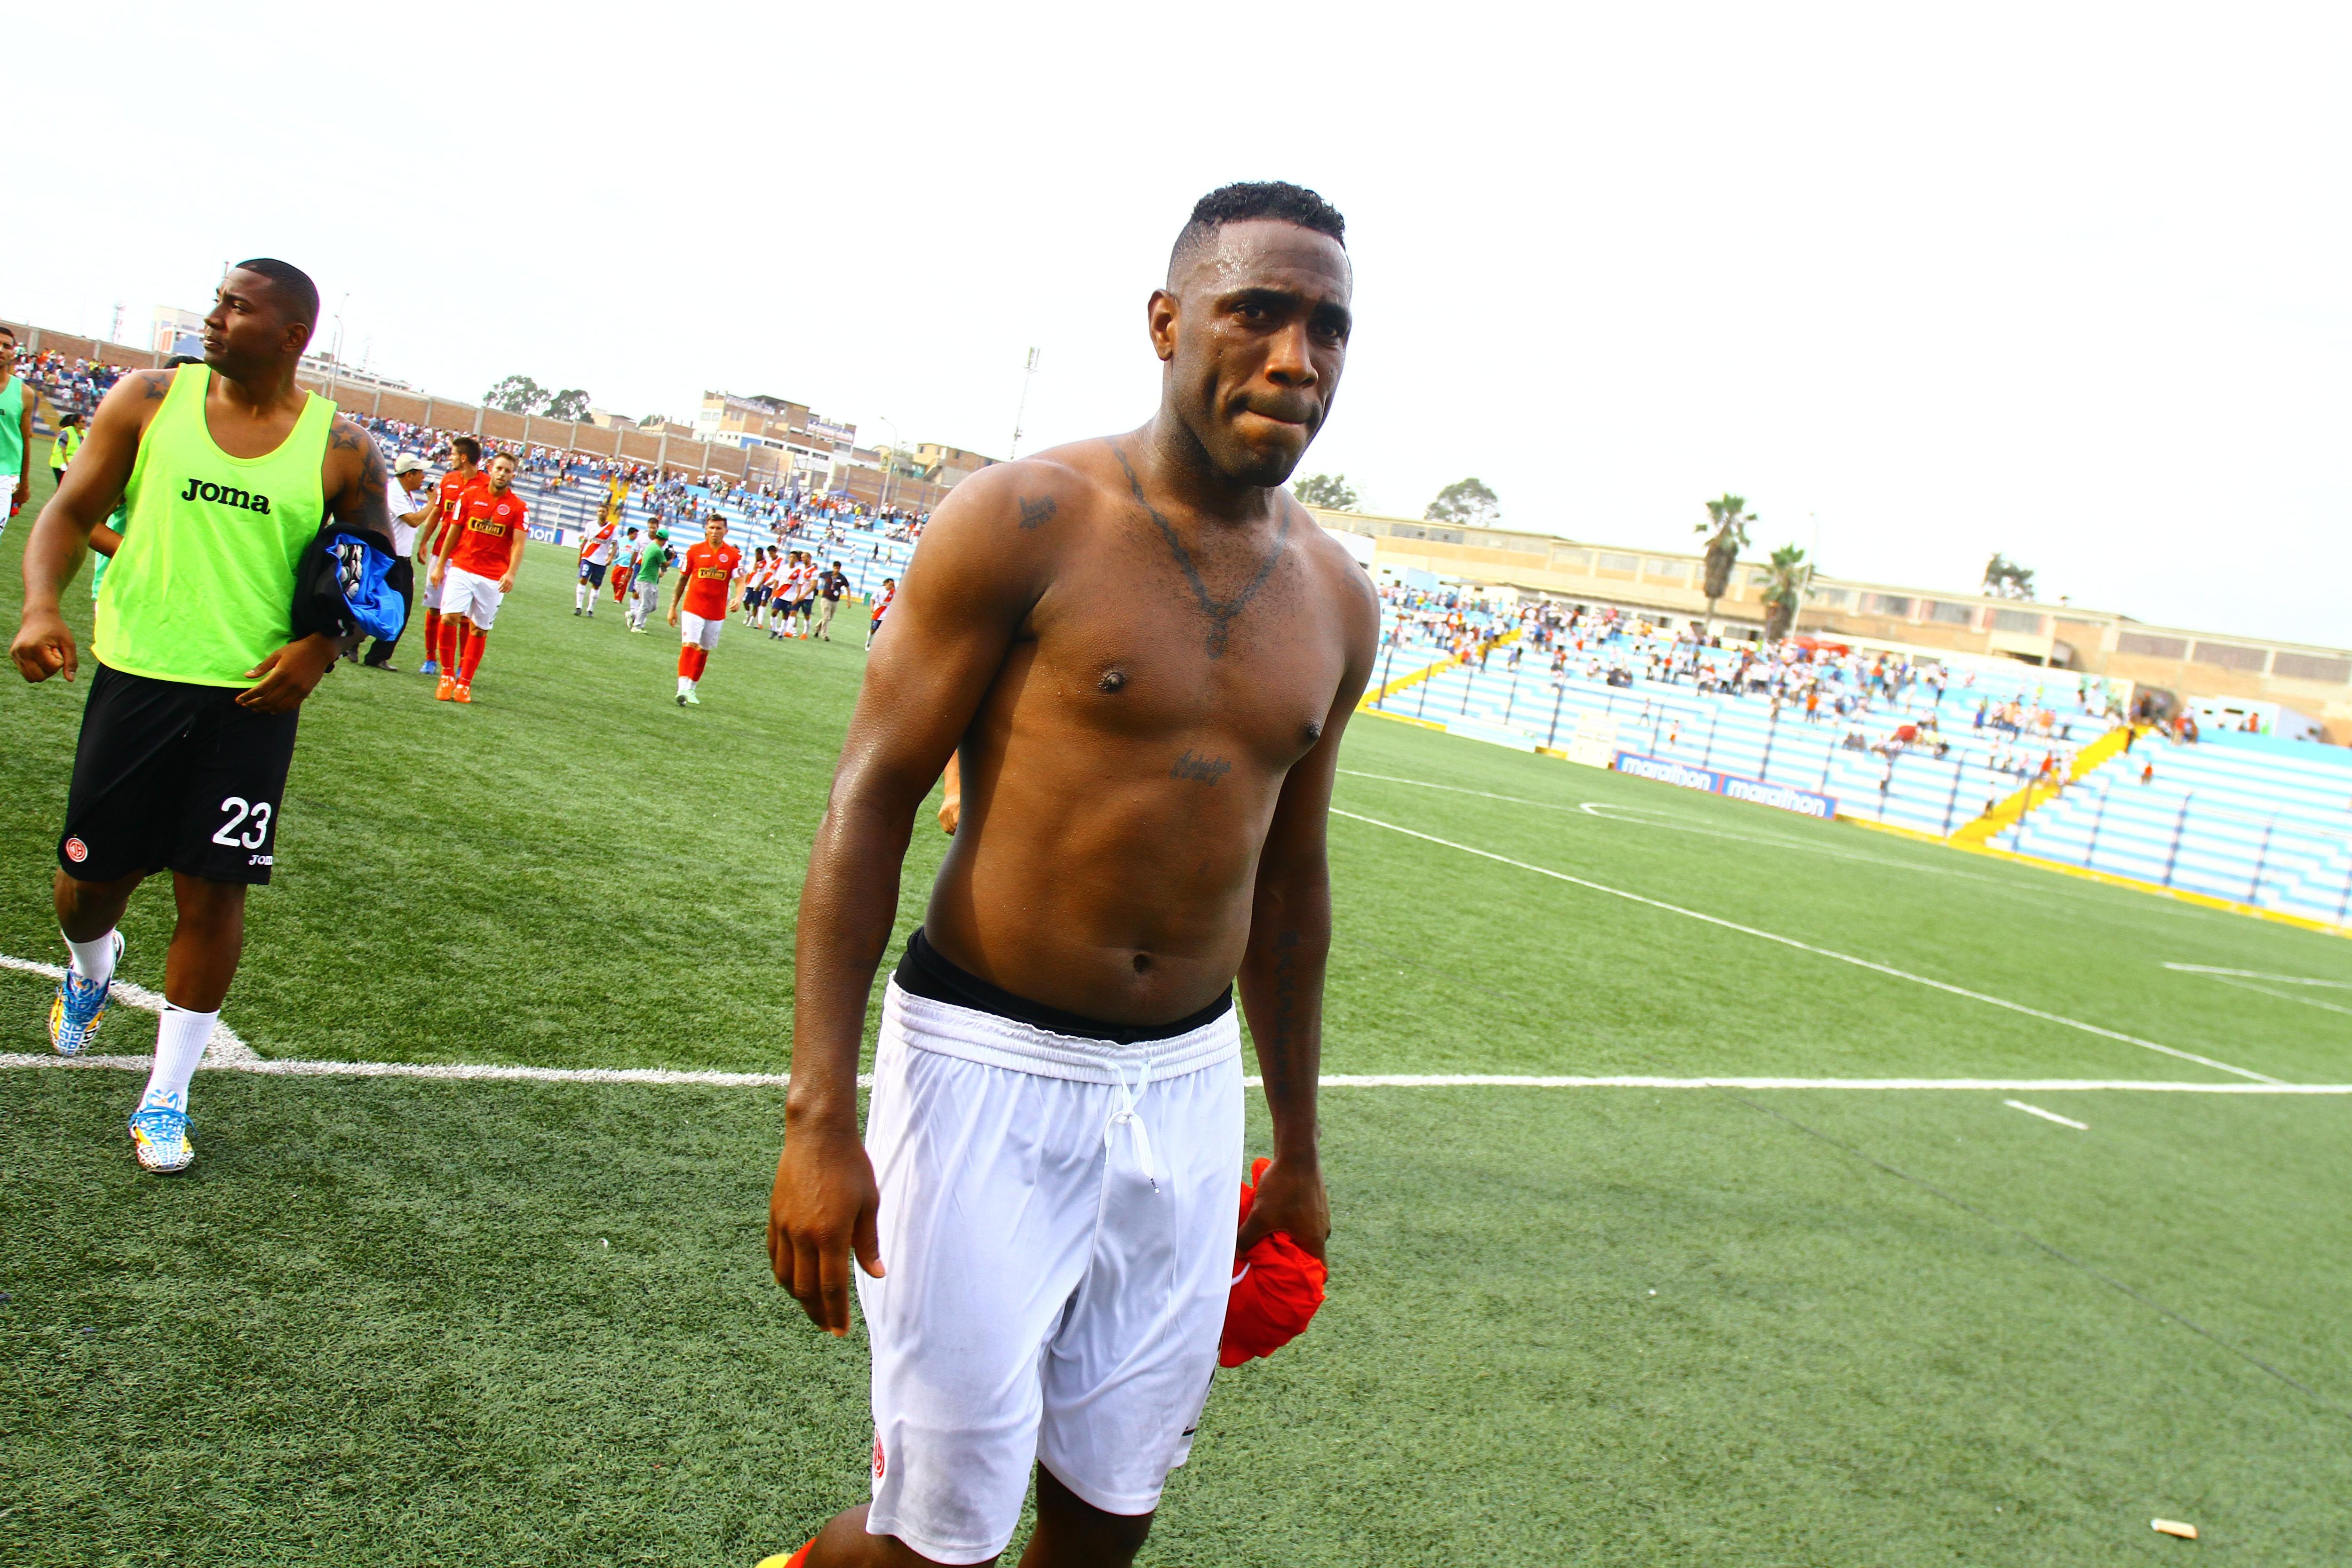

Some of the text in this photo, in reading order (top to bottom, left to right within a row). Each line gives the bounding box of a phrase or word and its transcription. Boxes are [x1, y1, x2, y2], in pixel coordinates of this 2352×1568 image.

[182, 478, 270, 515] Joma
[1621, 756, 1711, 791] marathon
[1727, 780, 1826, 817] marathon
[213, 796, 272, 850] 23
